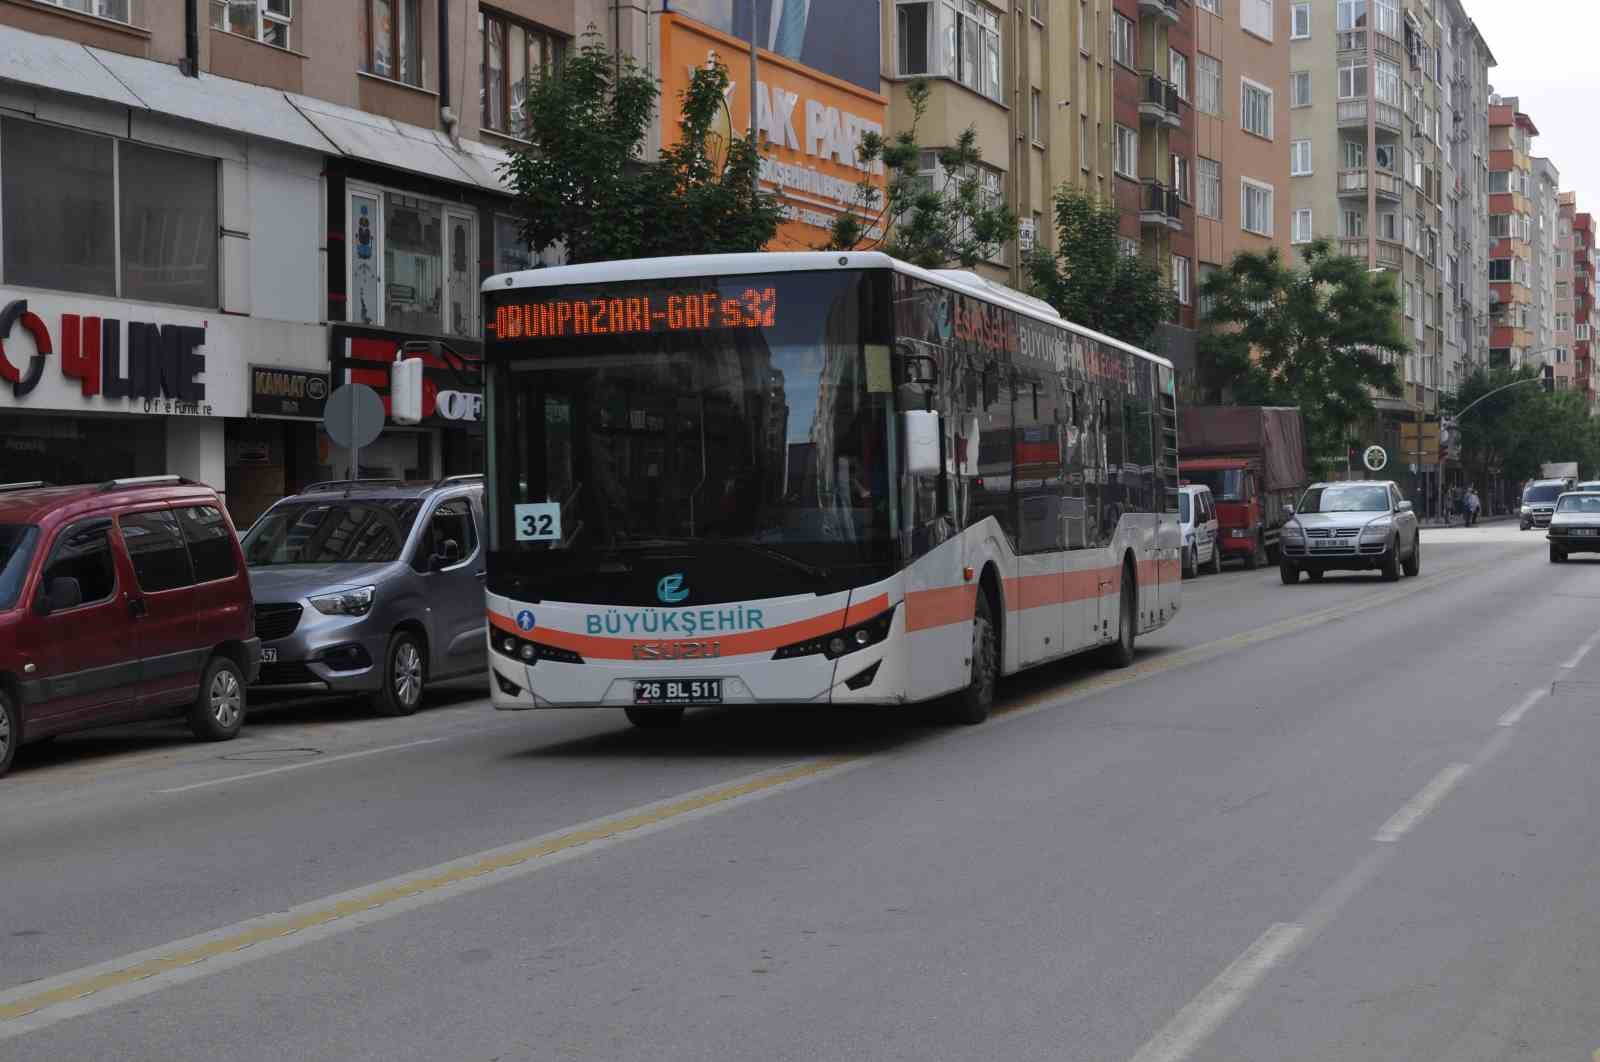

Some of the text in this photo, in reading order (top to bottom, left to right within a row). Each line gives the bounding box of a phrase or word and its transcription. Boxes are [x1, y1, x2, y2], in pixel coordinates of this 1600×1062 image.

[61, 313, 206, 401] 4LINE
[522, 514, 554, 537] 32
[586, 605, 765, 636] BÜYÜKŞEHİR
[632, 642, 721, 660] ISUZU
[641, 681, 718, 698] 26 BL 511
